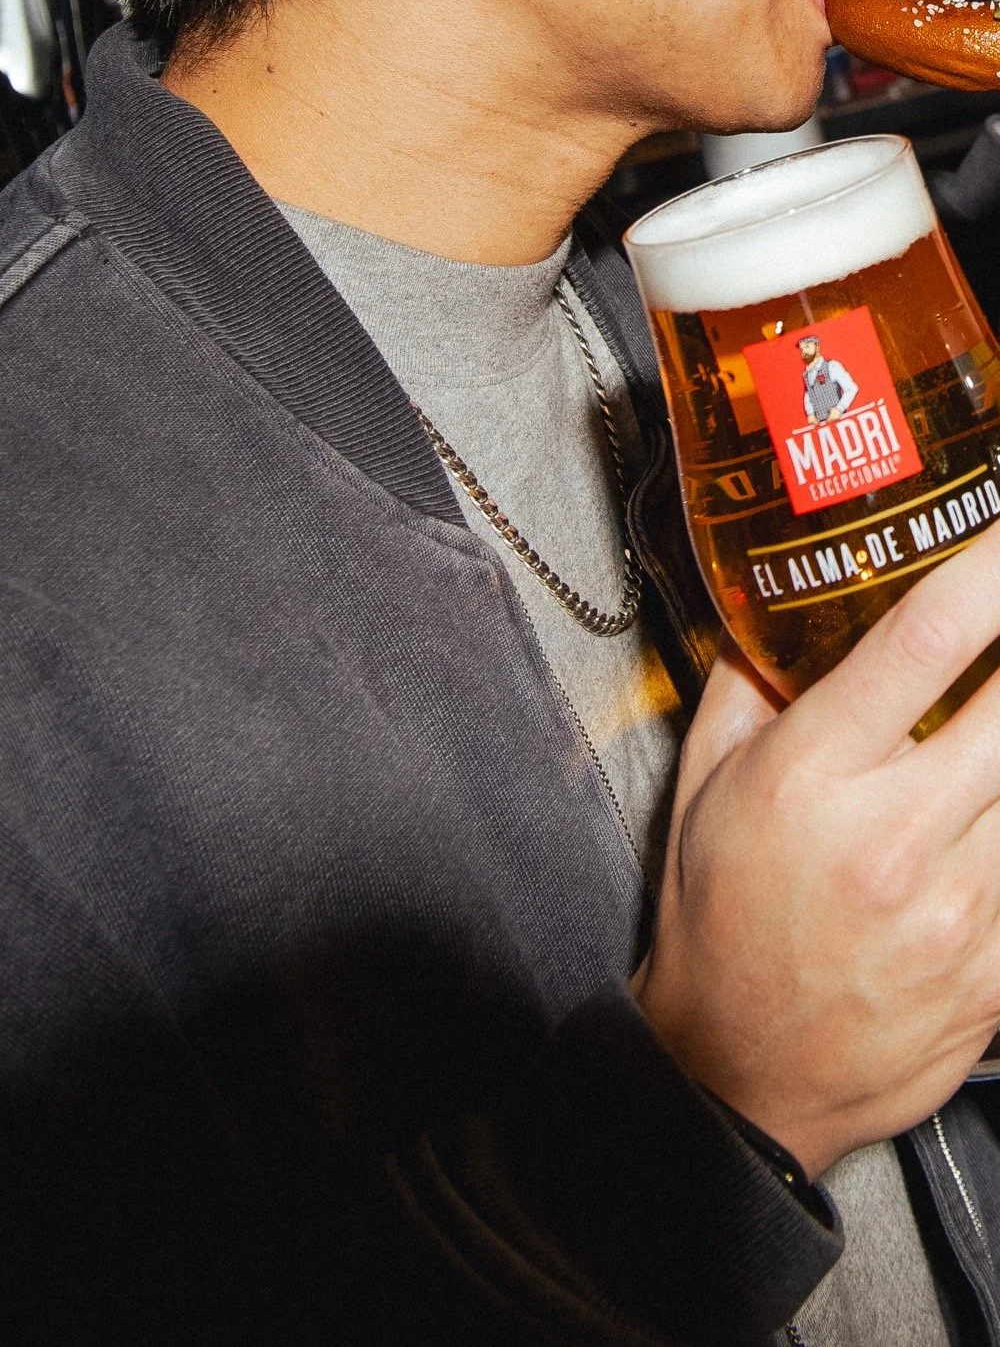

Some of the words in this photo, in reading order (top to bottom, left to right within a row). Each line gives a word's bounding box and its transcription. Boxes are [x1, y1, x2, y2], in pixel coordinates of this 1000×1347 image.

[809, 456, 898, 501] EXCEPCIONAL
[753, 563, 783, 598] EL
[788, 543, 862, 592] ALMA
[865, 526, 904, 568] DE
